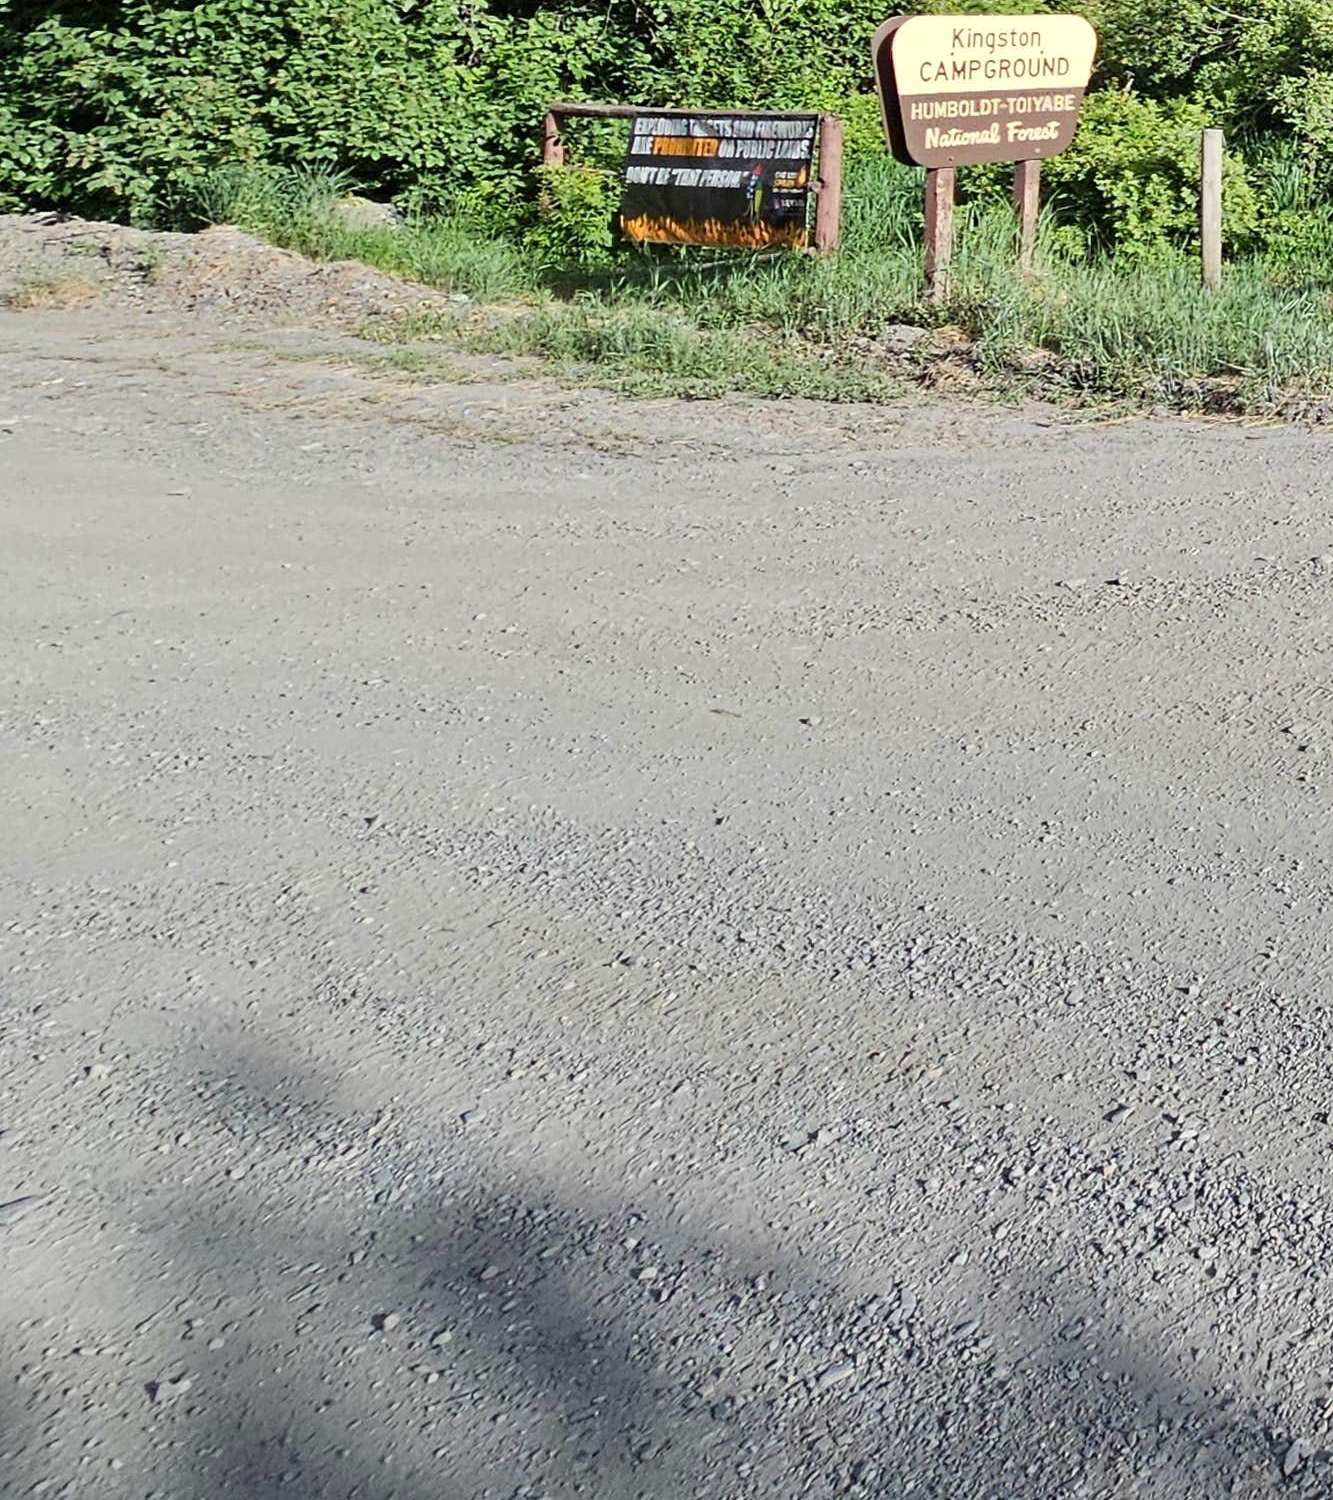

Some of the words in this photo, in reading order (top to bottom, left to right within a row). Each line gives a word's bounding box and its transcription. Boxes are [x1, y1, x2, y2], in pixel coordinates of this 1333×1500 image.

[952, 28, 1041, 54] Kingston
[920, 57, 1069, 81] CAMPGROUND
[911, 94, 1077, 120] HUMBOLDT-TOIYABE
[924, 122, 1000, 149] National
[1006, 120, 1061, 143] Forest
[718, 138, 736, 158] ON
[736, 139, 776, 159] PUBLIC
